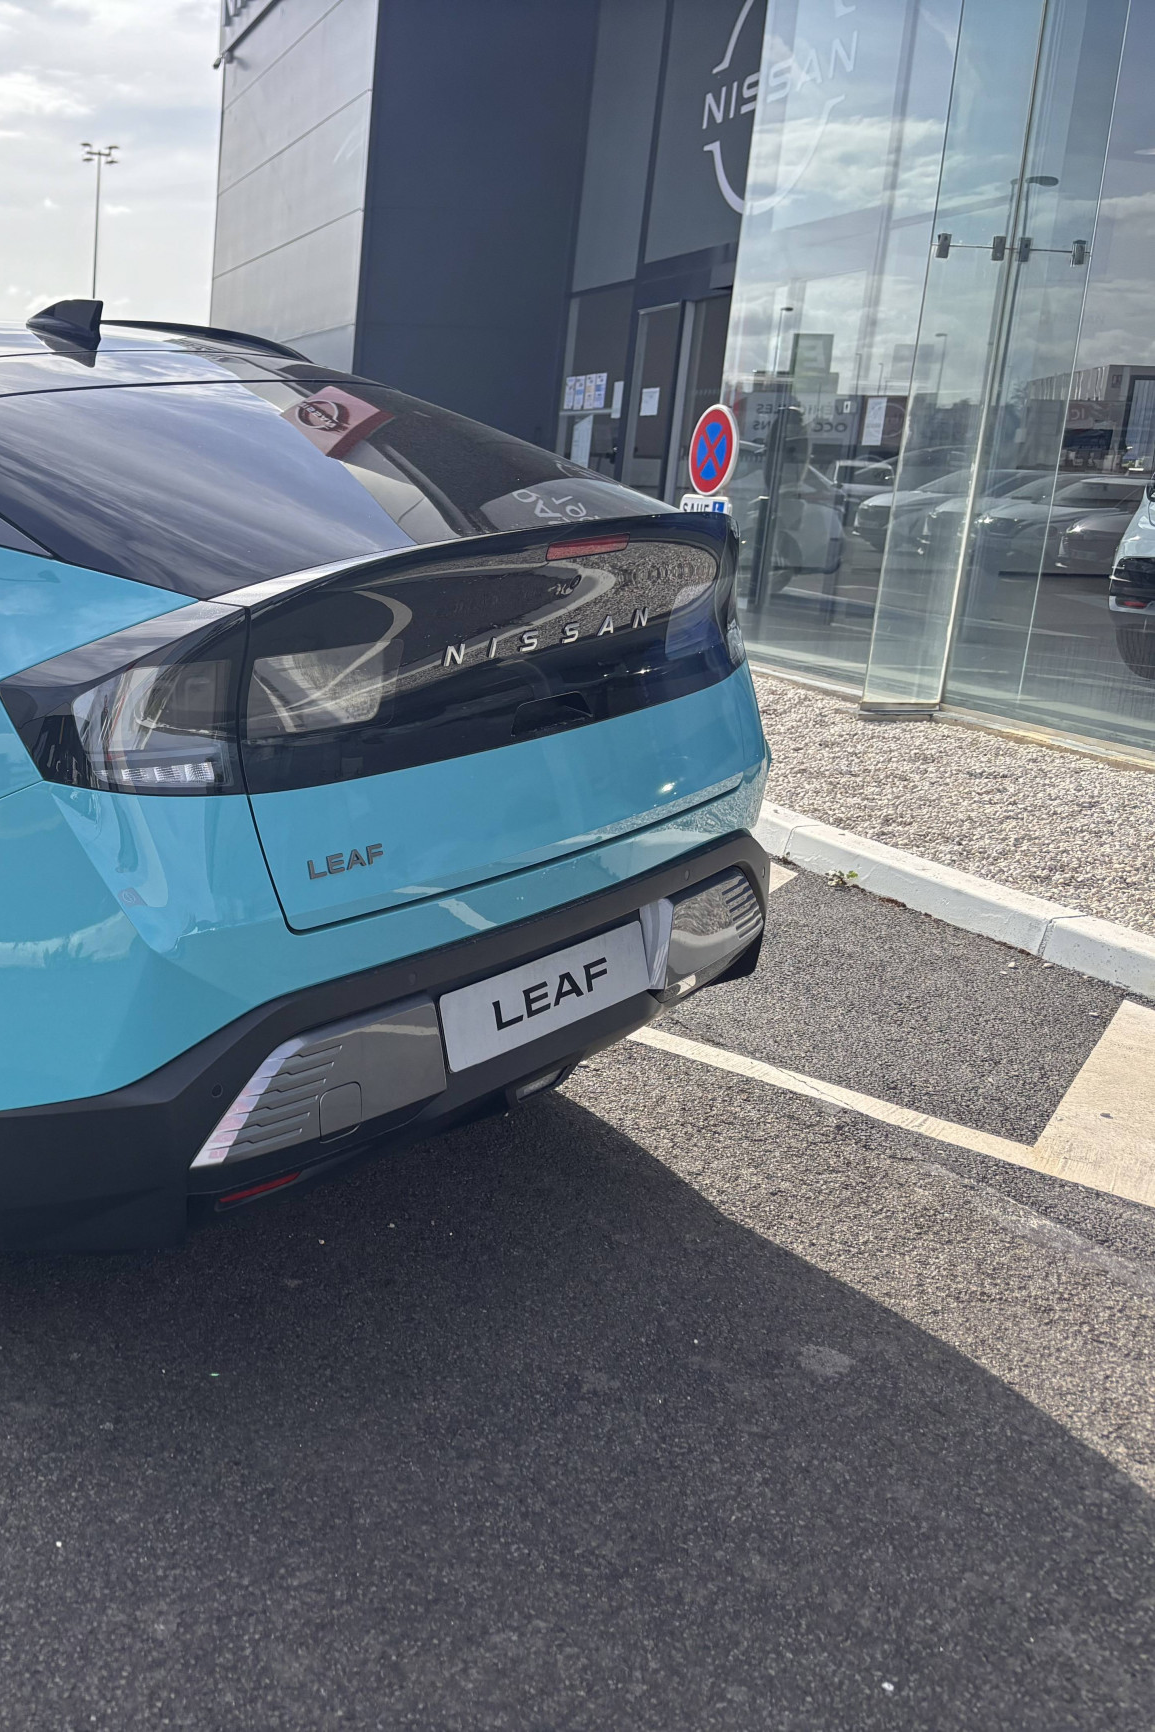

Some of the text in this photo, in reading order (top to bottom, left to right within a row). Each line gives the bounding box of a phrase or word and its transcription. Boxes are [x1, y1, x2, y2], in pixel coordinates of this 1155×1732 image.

[702, 30, 858, 129] NISSAN
[441, 607, 648, 667] NISSAN
[307, 843, 384, 880] LEAF
[492, 957, 607, 1031] LEAF
